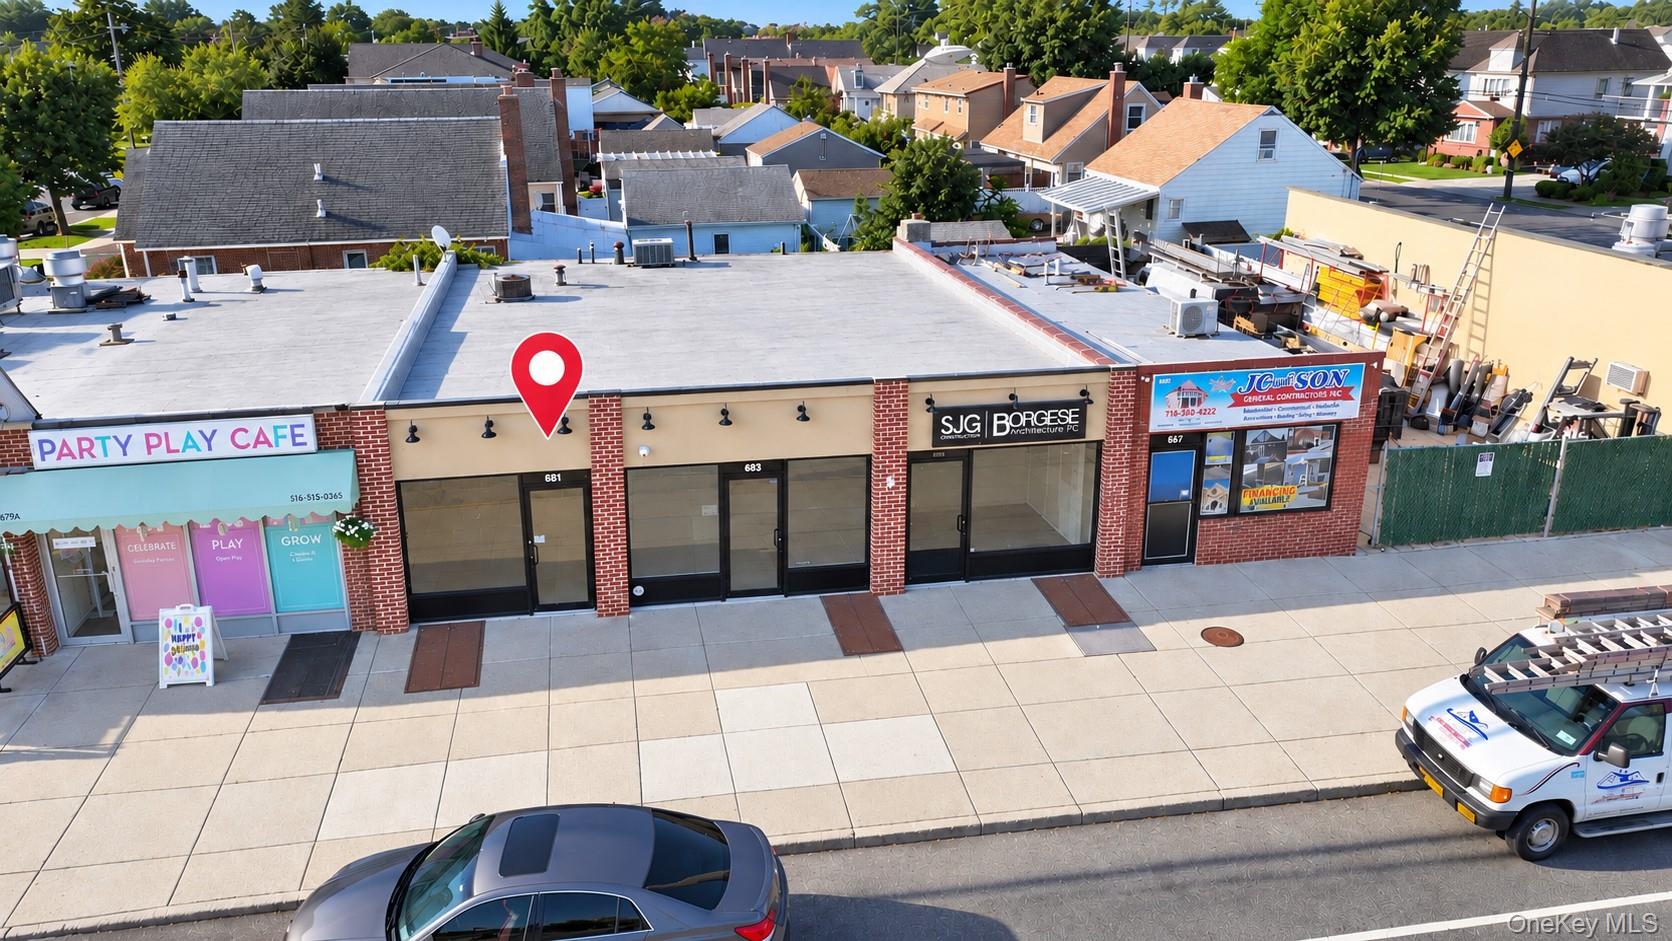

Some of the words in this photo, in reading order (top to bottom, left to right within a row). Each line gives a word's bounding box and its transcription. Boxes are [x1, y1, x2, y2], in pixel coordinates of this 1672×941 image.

[1238, 372, 1274, 395] JC
[1293, 368, 1351, 390] SON
[1276, 391, 1327, 401] CONTRACTORS
[940, 414, 982, 435] SJG
[993, 408, 1080, 437] BORGESE
[1010, 425, 1064, 435] Architecture
[1066, 424, 1079, 433] PC
[37, 434, 133, 462] PARTY
[145, 429, 218, 456] PLAY
[230, 424, 308, 450] CAFE
[1167, 435, 1184, 444] 667
[744, 463, 762, 472] 683
[544, 473, 561, 482] 681
[289, 492, 344, 503] 516-515-0365
[1243, 486, 1296, 499] FINANCING
[0, 512, 21, 521] 679A
[212, 538, 243, 550] PLAY
[281, 534, 322, 546] GROW
[127, 542, 177, 553] CELEBRATE
